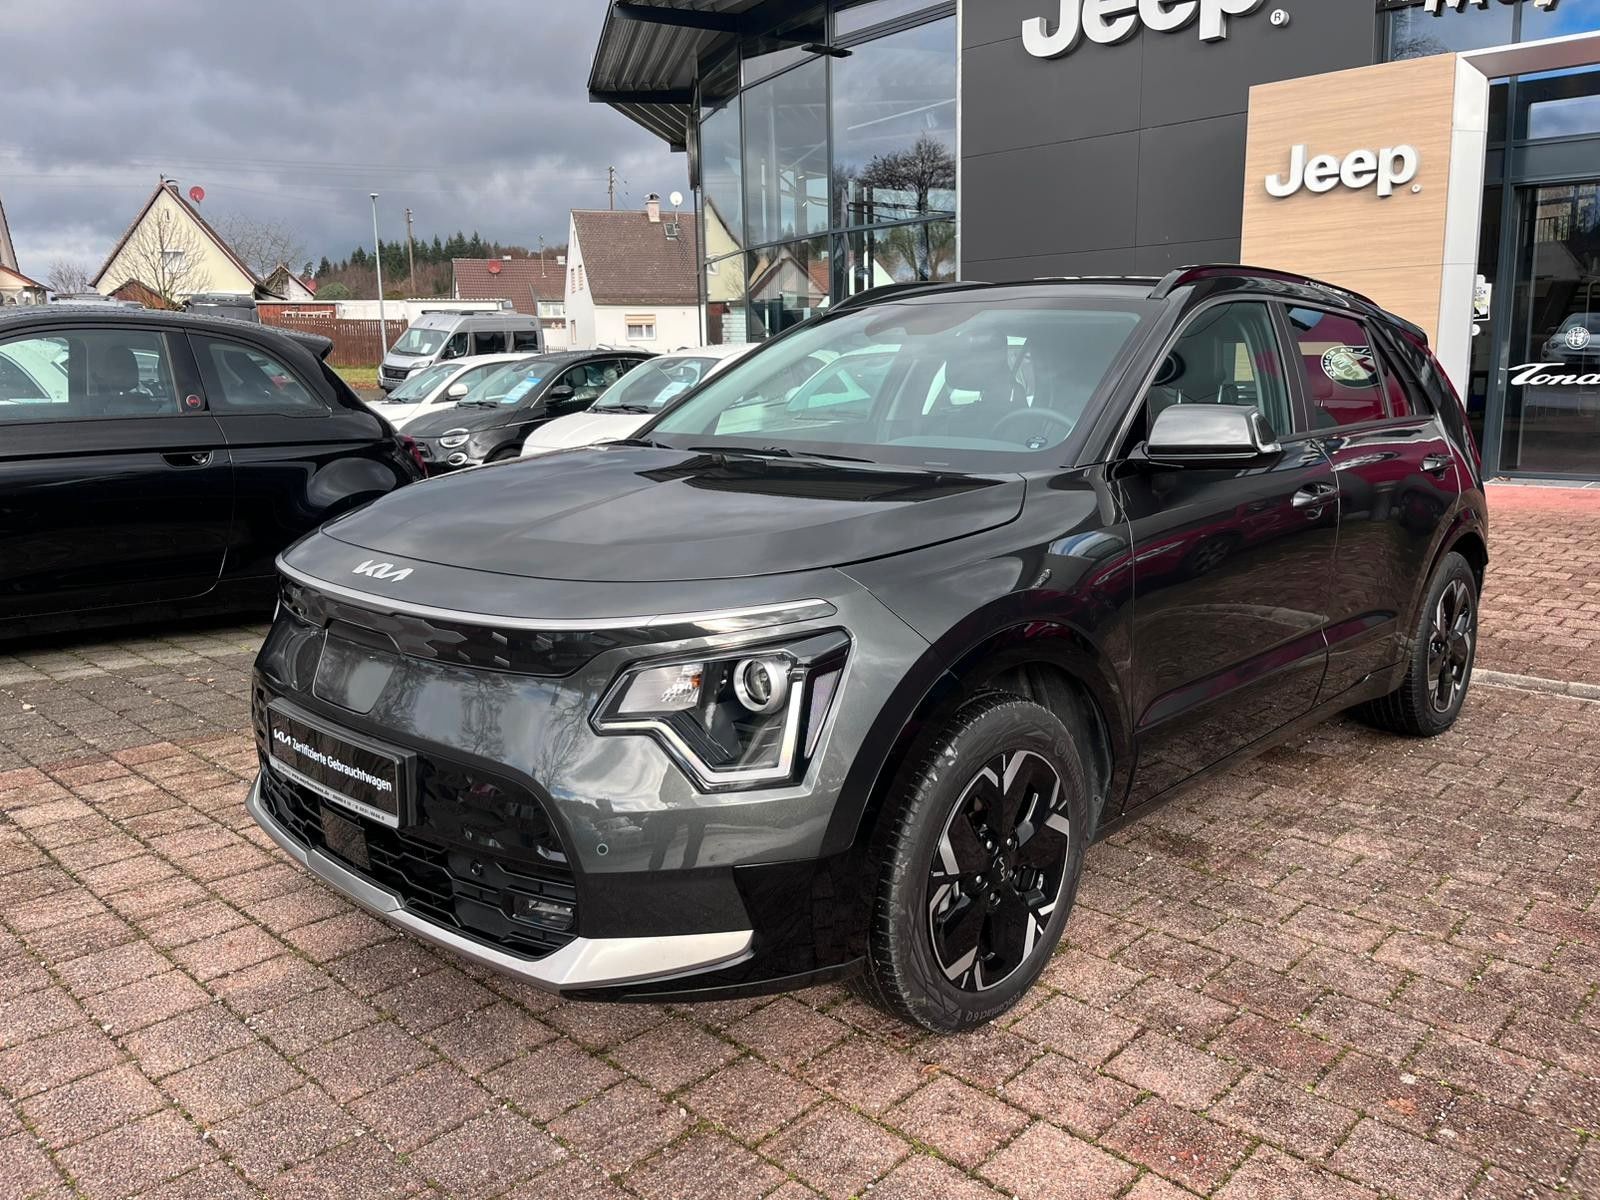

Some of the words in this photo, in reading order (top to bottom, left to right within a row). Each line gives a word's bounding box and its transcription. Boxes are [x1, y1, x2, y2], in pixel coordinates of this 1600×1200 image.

[1265, 144, 1419, 198] Jeep
[352, 559, 415, 583] KIA
[273, 727, 291, 746] KIA
[292, 738, 327, 766] Zertifizierte
[327, 755, 392, 792] Gebrauchtwagen
